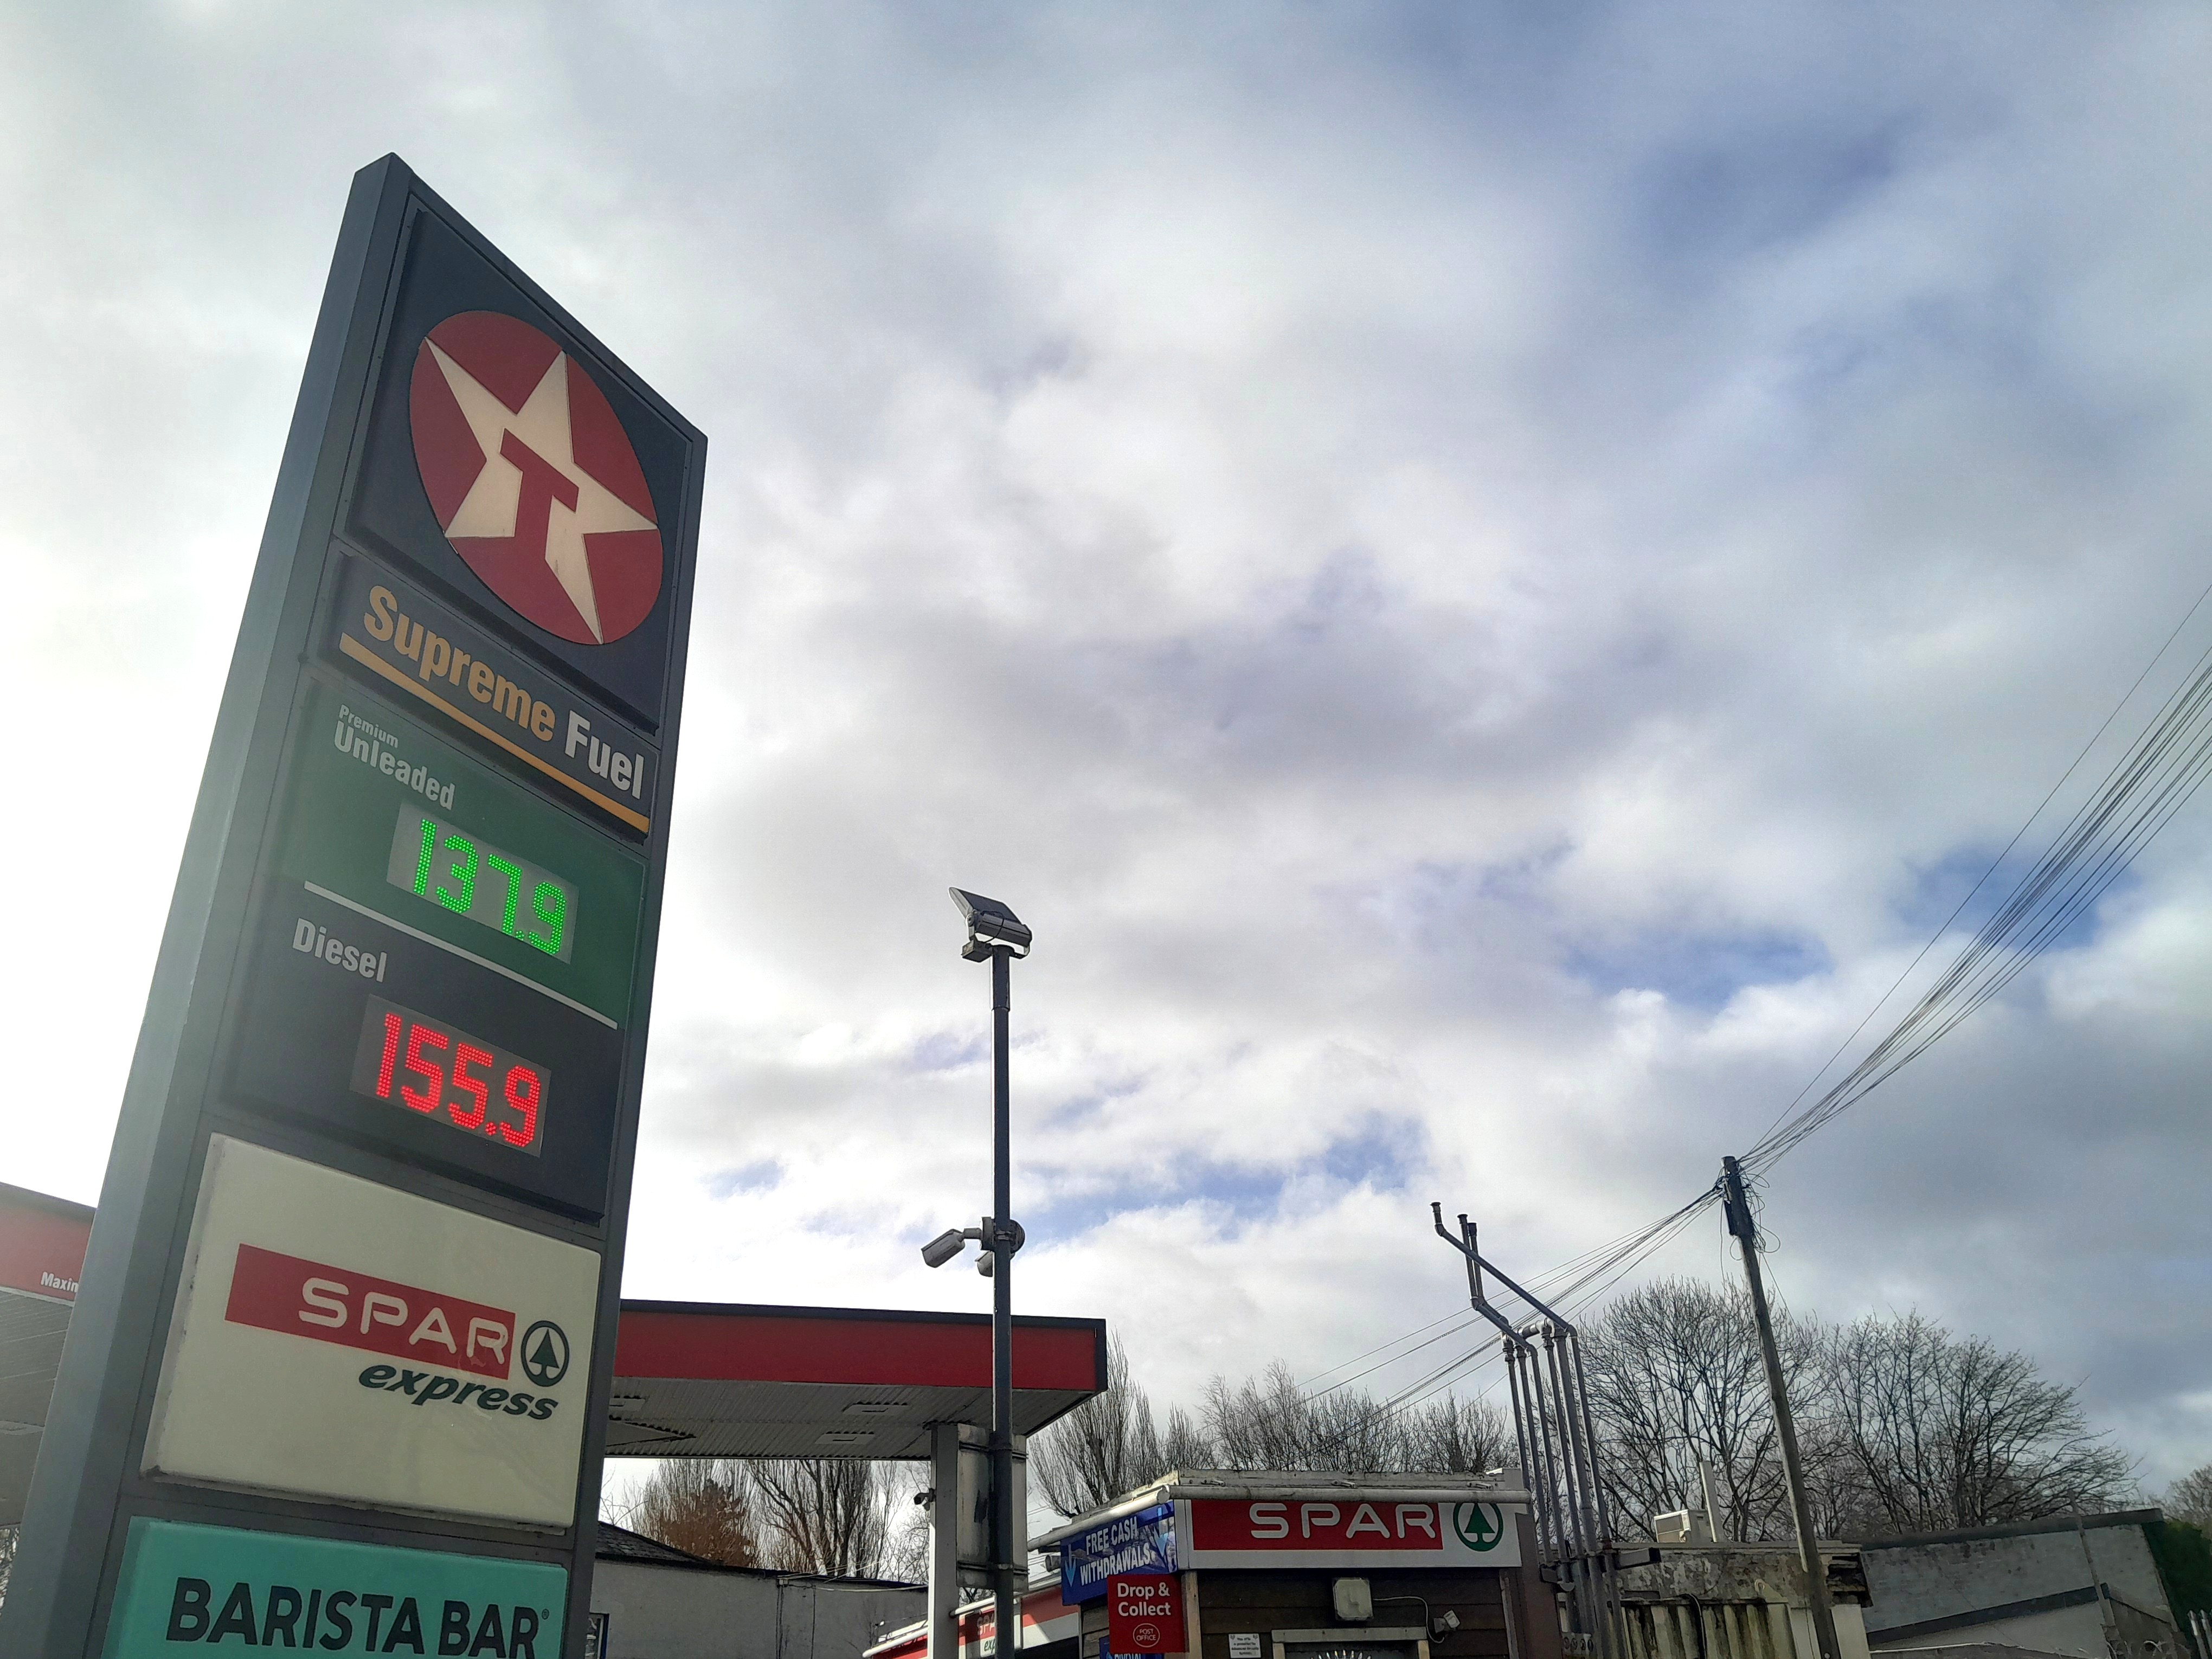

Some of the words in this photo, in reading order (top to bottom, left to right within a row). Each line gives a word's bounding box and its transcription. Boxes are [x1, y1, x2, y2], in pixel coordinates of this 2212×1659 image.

[363, 585, 556, 742] Supreme
[565, 710, 645, 800] Fuel
[339, 704, 398, 748] Premium
[335, 721, 455, 810] Unleaded
[413, 818, 567, 955] 137.9
[292, 917, 387, 982] Diesel
[375, 1012, 541, 1148] 155.9
[298, 1277, 509, 1365] SPAR
[358, 1365, 558, 1420] express
[1086, 1528, 1109, 1555] FREE
[1111, 1516, 1137, 1545] CASH
[1249, 1503, 1436, 1538] SPAR
[1080, 1542, 1150, 1586] WITHDRAWALS
[1117, 1583, 1154, 1600] Drop
[1158, 1582, 1170, 1596] &
[166, 1577, 425, 1655] BARISTA
[1118, 1602, 1171, 1616] Collect
